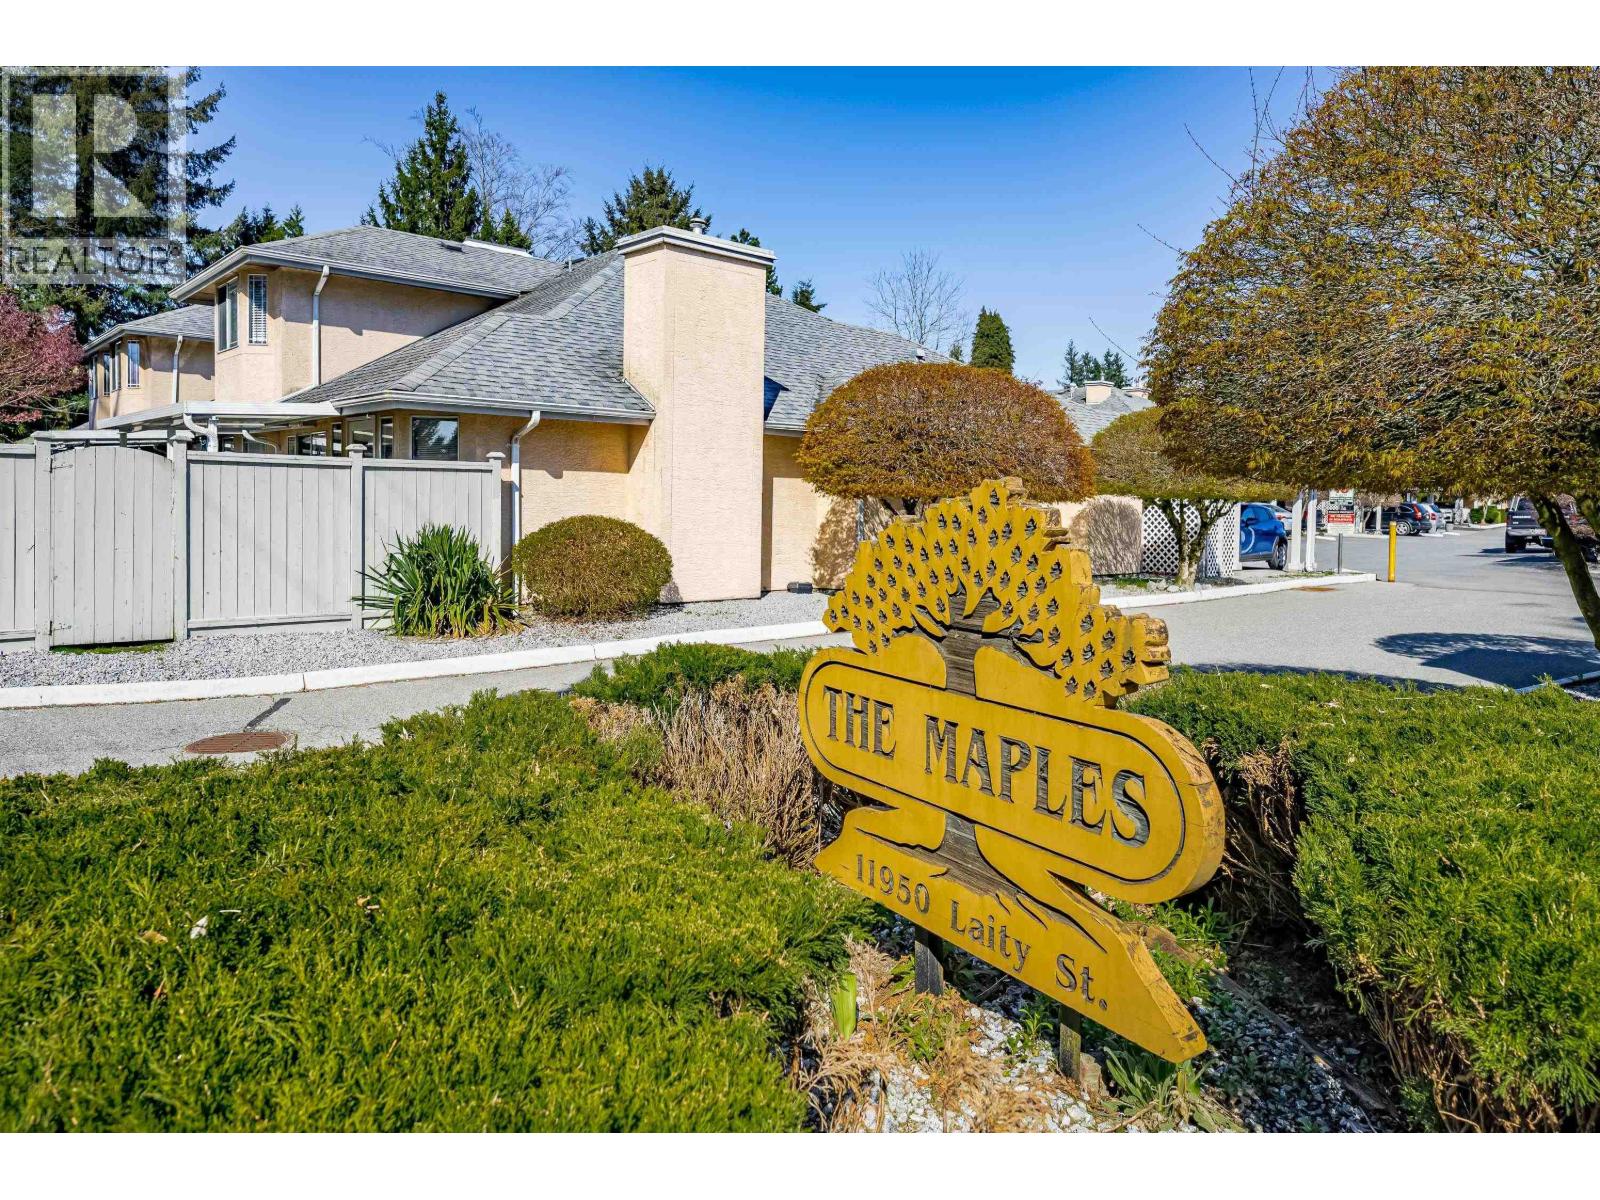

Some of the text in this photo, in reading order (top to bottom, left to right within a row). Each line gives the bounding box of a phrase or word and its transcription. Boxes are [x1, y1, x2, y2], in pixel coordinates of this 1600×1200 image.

[823, 686, 1151, 848] THE MAPLES
[856, 853, 1108, 1011] 11950 Laity St.
